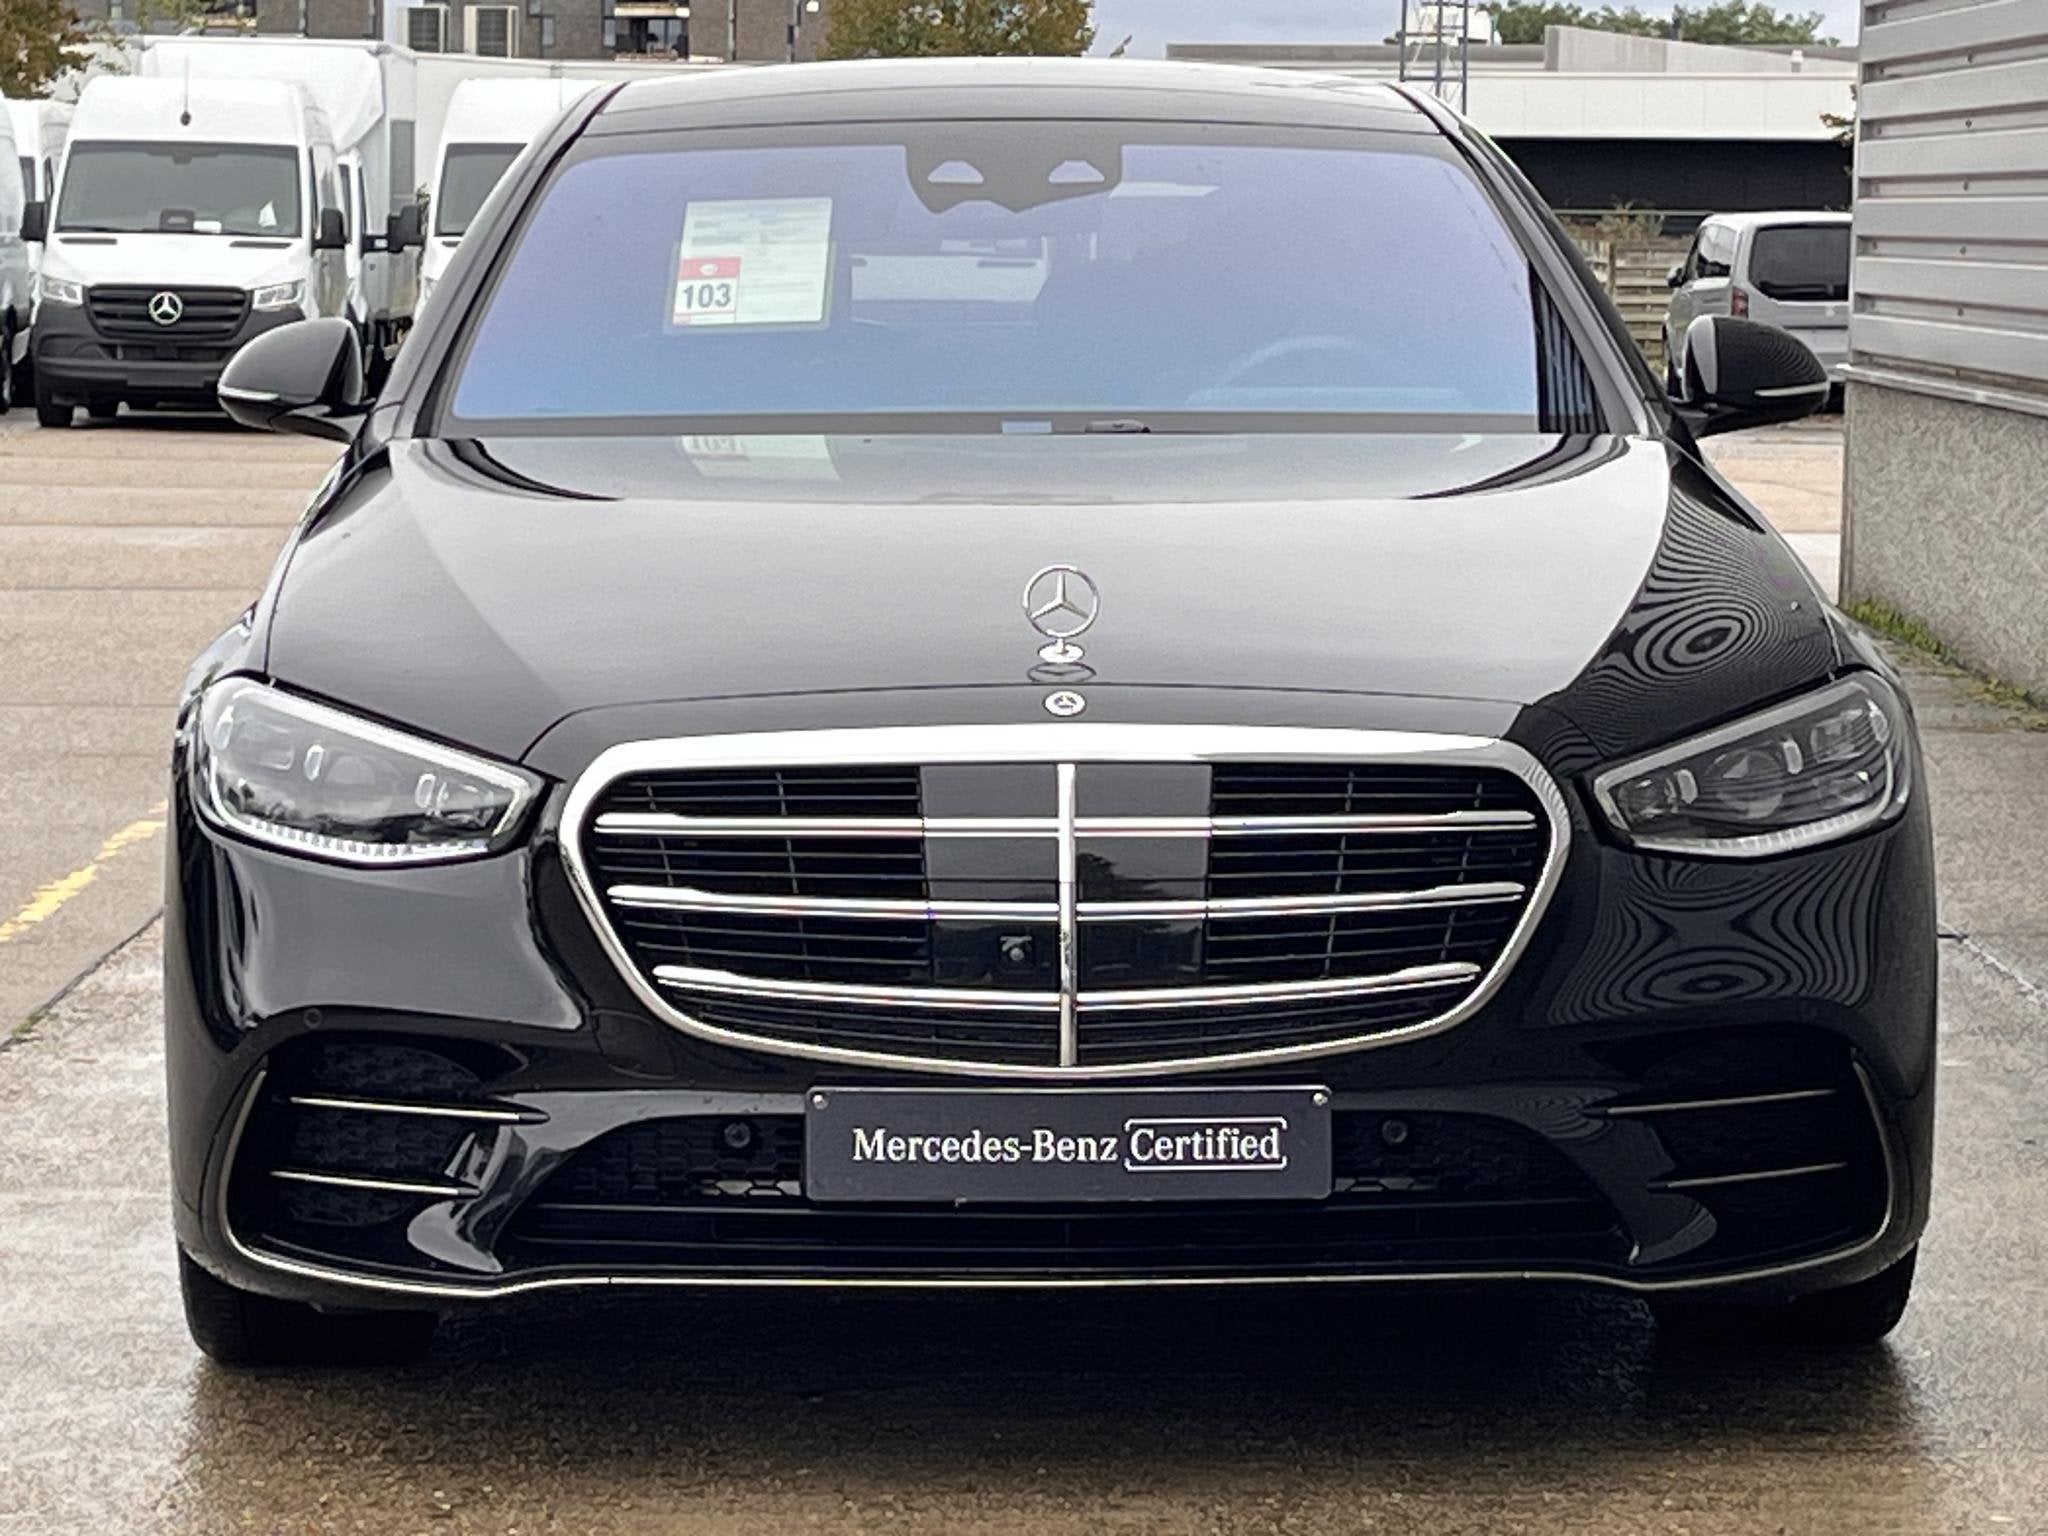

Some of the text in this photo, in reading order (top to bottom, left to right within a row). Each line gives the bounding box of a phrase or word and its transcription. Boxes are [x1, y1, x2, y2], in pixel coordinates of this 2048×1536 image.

[683, 283, 731, 310] 103
[852, 1128, 1281, 1162] Mercedes-Benz Certified
